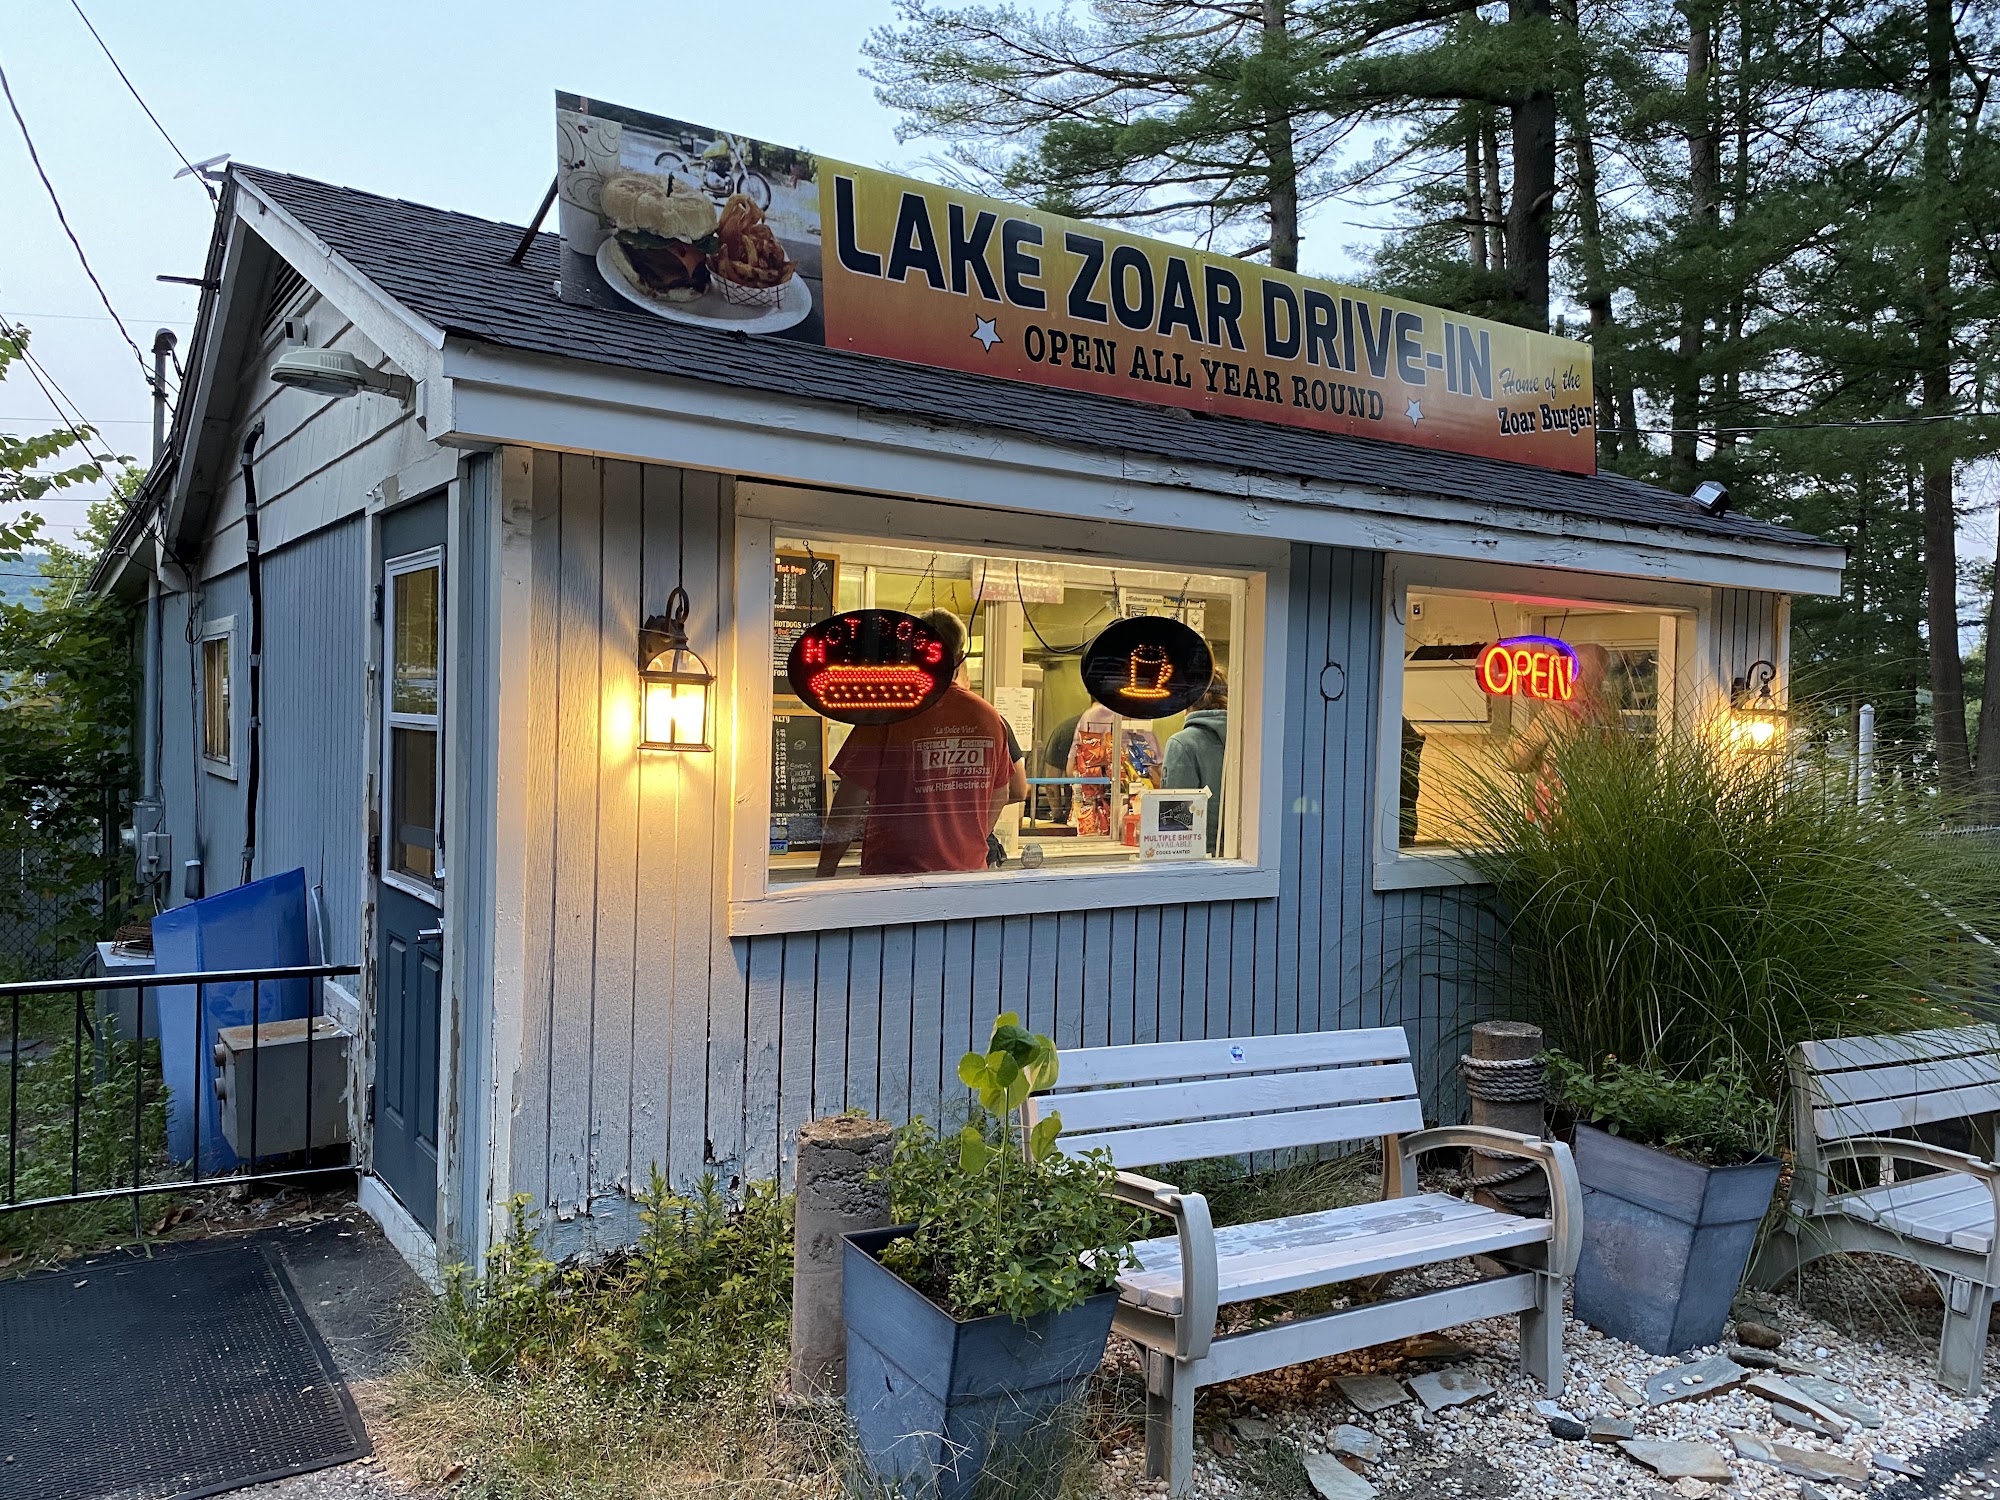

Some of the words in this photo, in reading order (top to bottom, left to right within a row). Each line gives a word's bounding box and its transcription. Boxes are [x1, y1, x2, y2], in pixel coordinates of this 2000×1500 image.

[834, 174, 1047, 311] LAKE
[1064, 230, 1247, 352] ZOAR
[1261, 278, 1494, 400] DRIVE-IN
[1024, 324, 1117, 375] OPEN
[1128, 345, 1192, 389] ALL
[1200, 358, 1283, 404] YEAR
[1291, 375, 1384, 421] ROUND
[1499, 367, 1540, 396] Home
[1544, 367, 1557, 400] of
[1562, 364, 1581, 392] the
[1497, 406, 1536, 436] Zoar
[1539, 403, 1592, 437] Burger
[804, 617, 861, 663] HOT
[876, 616, 943, 663] DOGS
[1484, 647, 1573, 700] OPEN
[773, 715, 790, 723] ALTY
[928, 750, 979, 767] RIZZO
[1143, 834, 1177, 842] MULTIPLE
[1178, 833, 1202, 841] SHIFTS
[1156, 840, 1193, 848] AVAILABLE
